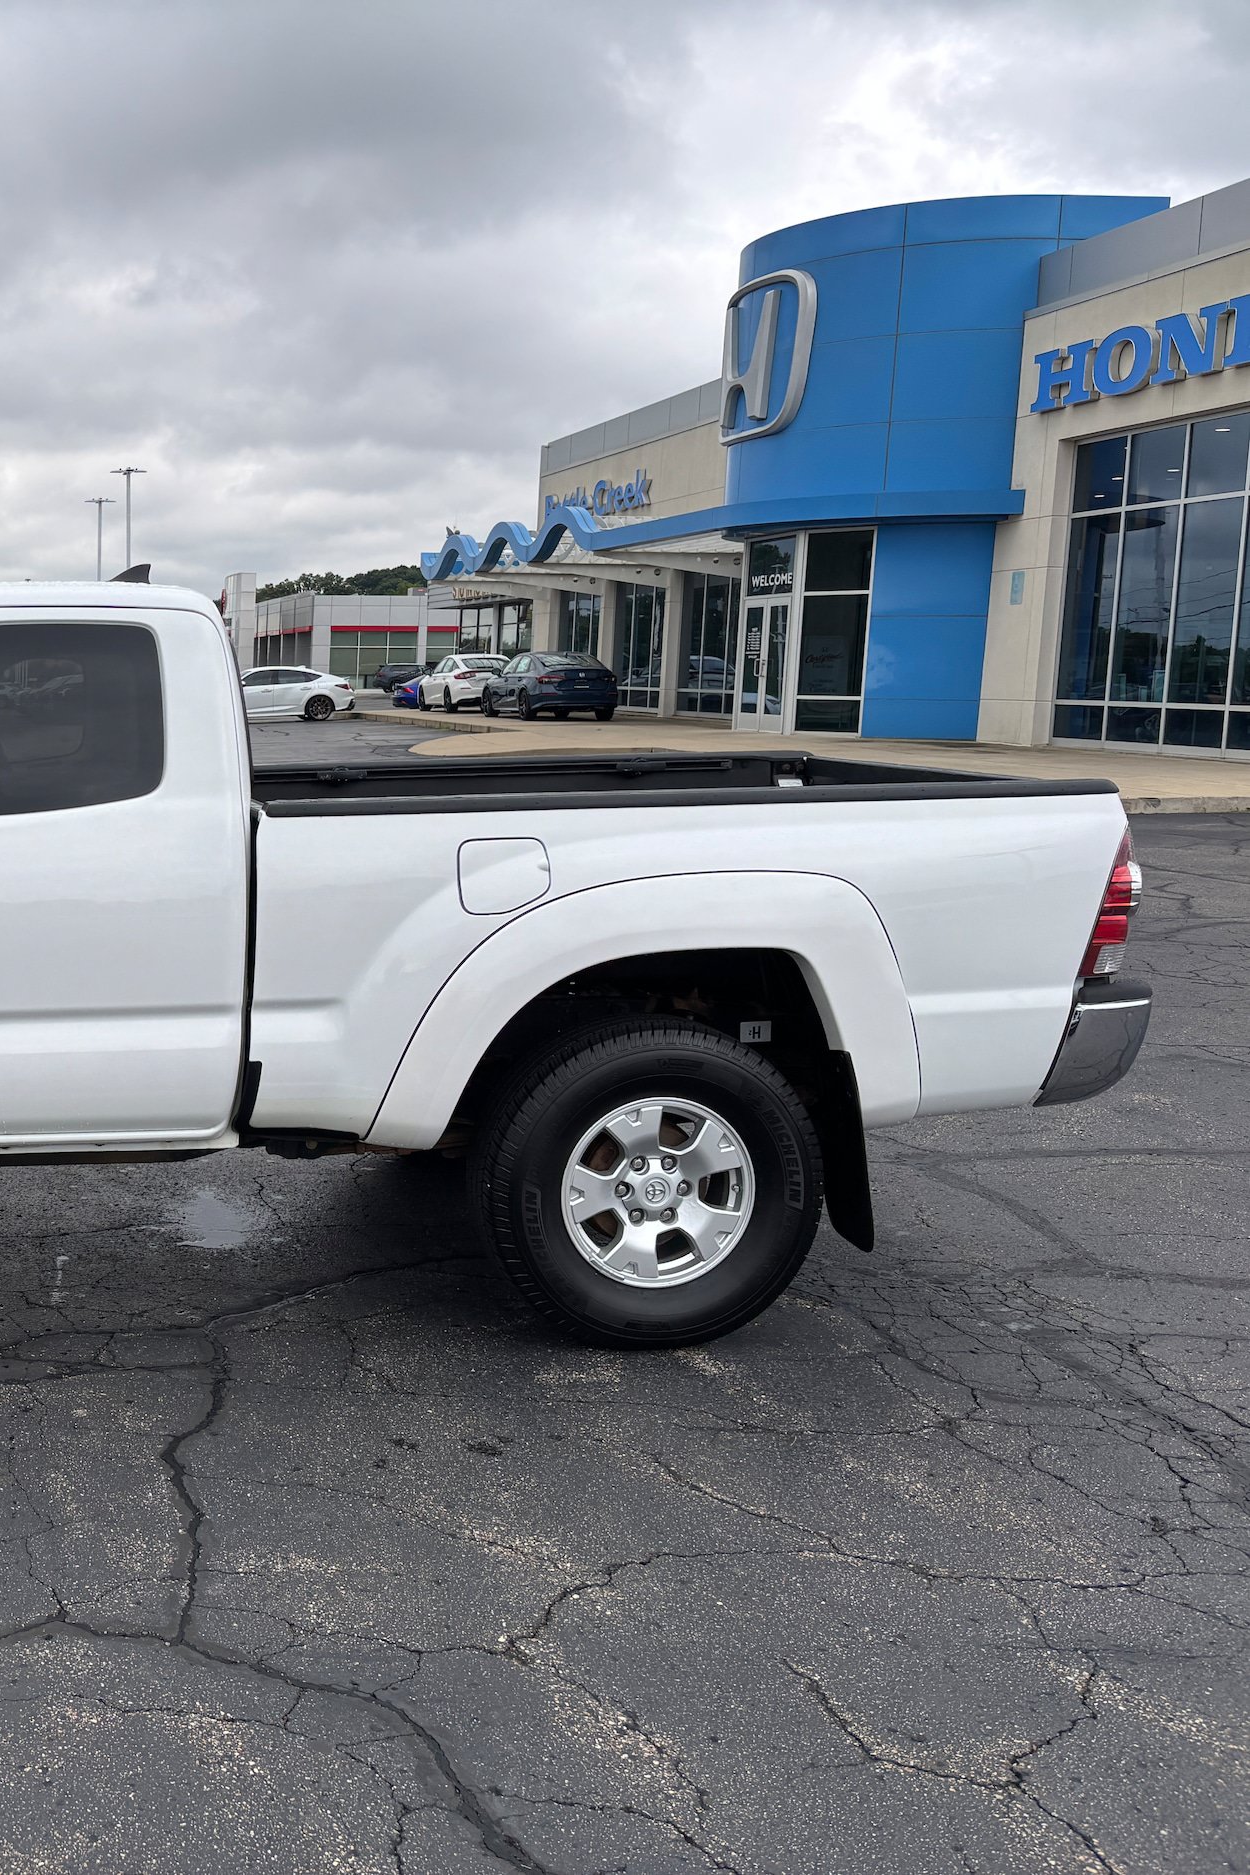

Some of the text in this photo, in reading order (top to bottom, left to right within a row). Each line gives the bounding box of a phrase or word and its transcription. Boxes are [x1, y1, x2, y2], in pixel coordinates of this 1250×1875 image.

[593, 468, 653, 516] Creek
[752, 573, 793, 587] WELCOME
[762, 1108, 801, 1203] MICHELIN
